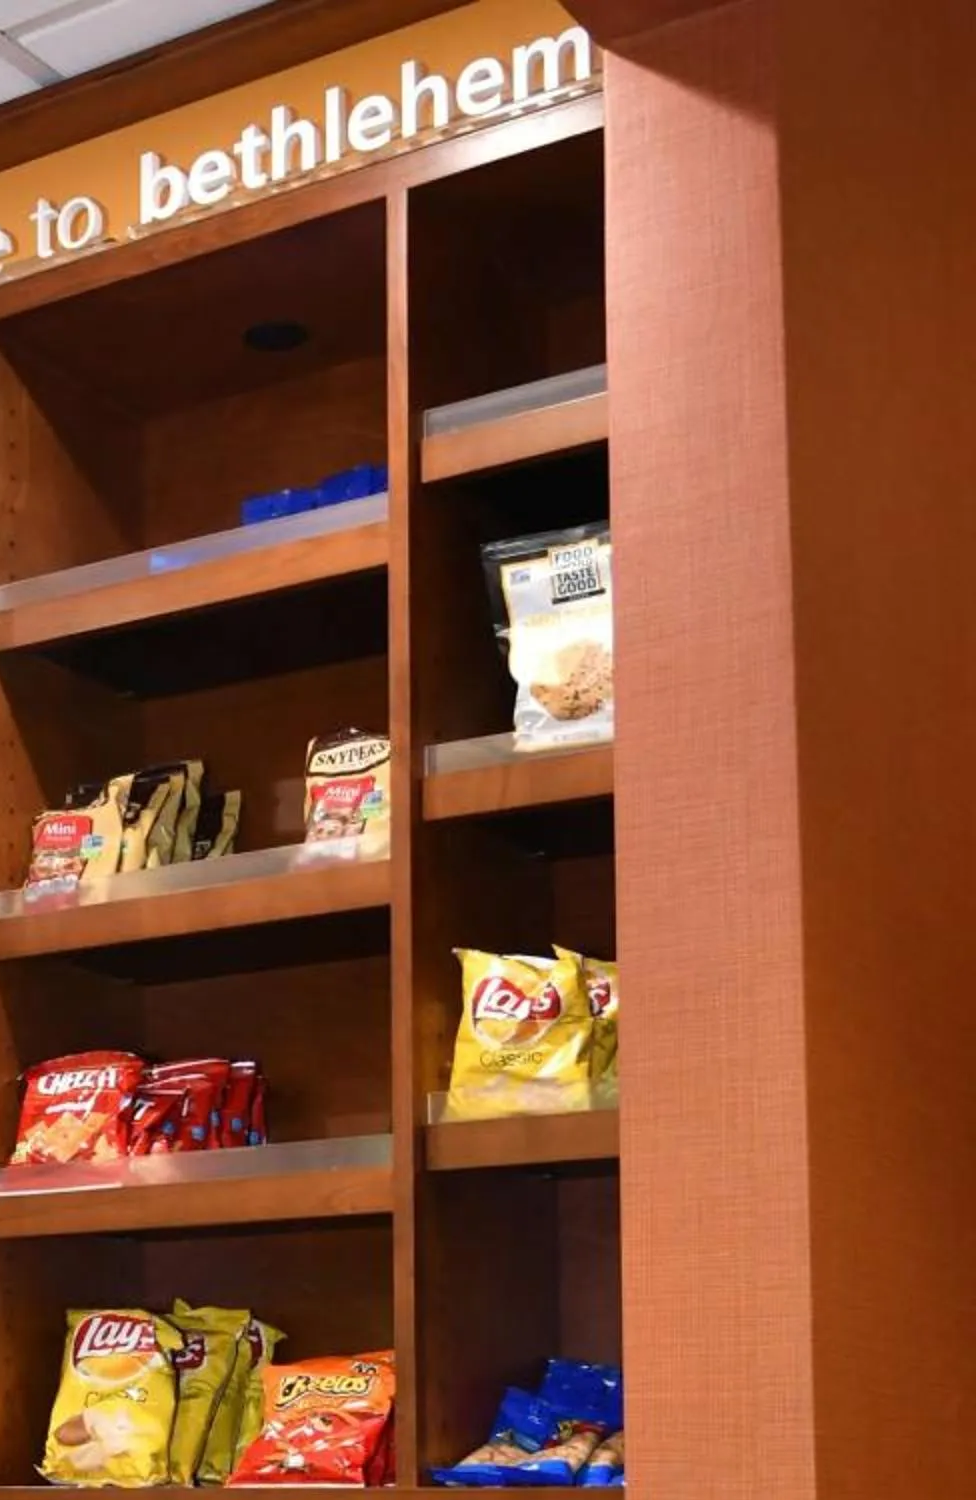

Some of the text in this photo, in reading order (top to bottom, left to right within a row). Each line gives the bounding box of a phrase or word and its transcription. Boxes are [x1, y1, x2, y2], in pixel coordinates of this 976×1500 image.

[29, 196, 105, 260] to
[138, 25, 592, 225] bethlehem
[556, 567, 595, 583] TASTE
[558, 577, 597, 595] GOOD
[43, 822, 77, 836] Mini
